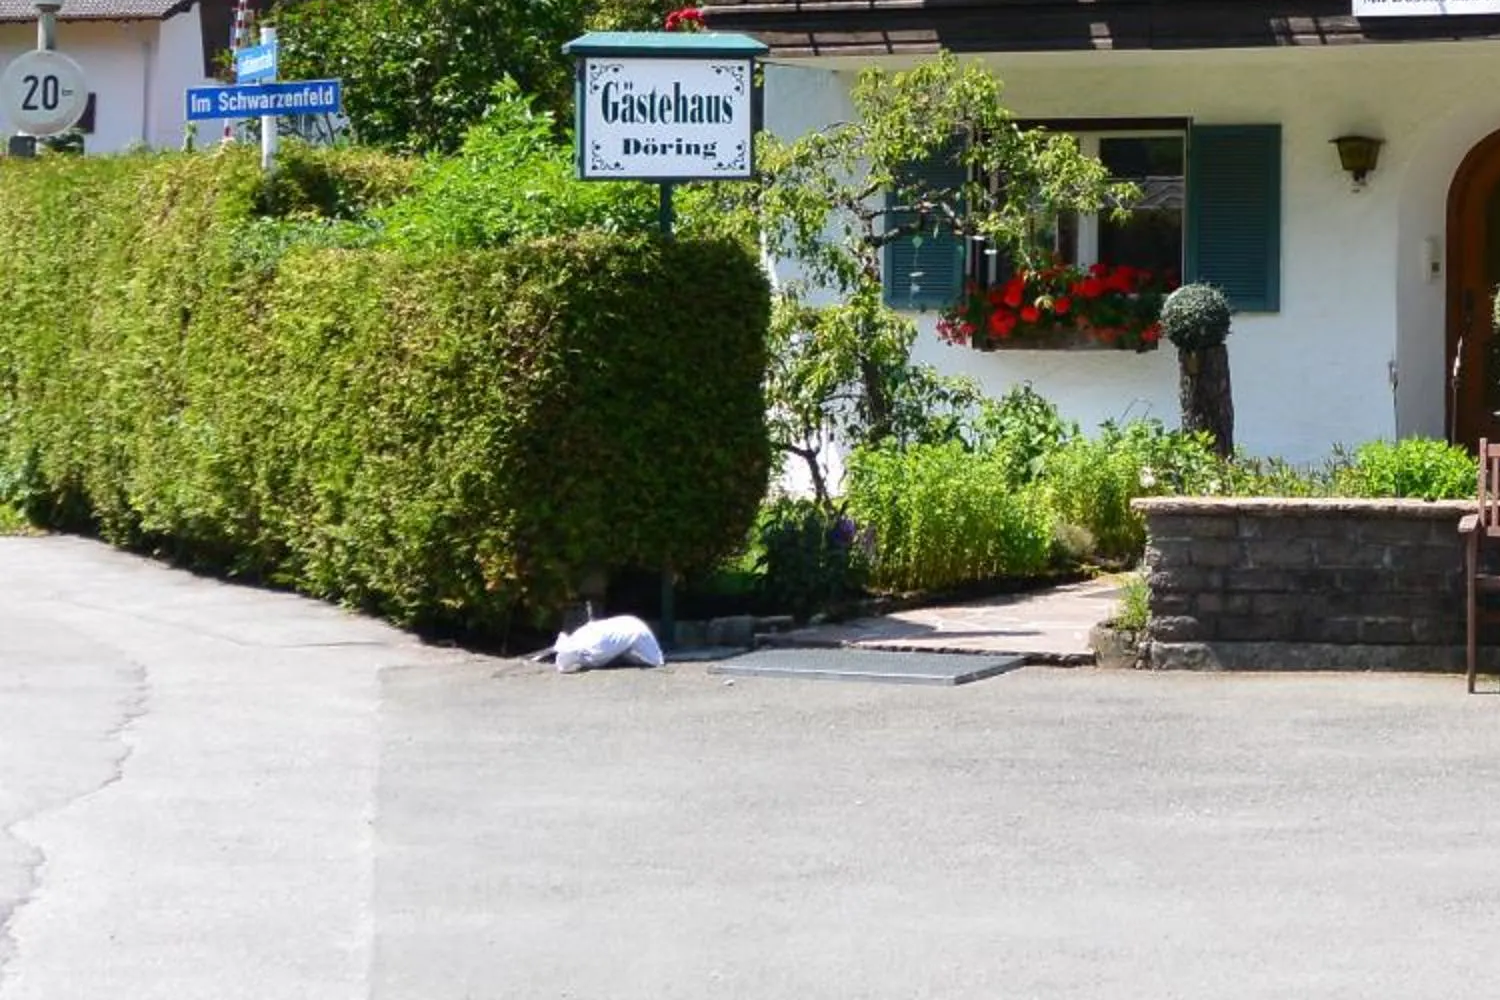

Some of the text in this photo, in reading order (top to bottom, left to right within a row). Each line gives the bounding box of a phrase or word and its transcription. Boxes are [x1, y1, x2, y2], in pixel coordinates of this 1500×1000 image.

[22, 74, 60, 111] 20
[191, 85, 334, 113] Im Schwarzenfeld
[601, 80, 733, 125] Gästehaus
[622, 137, 718, 160] Döring
